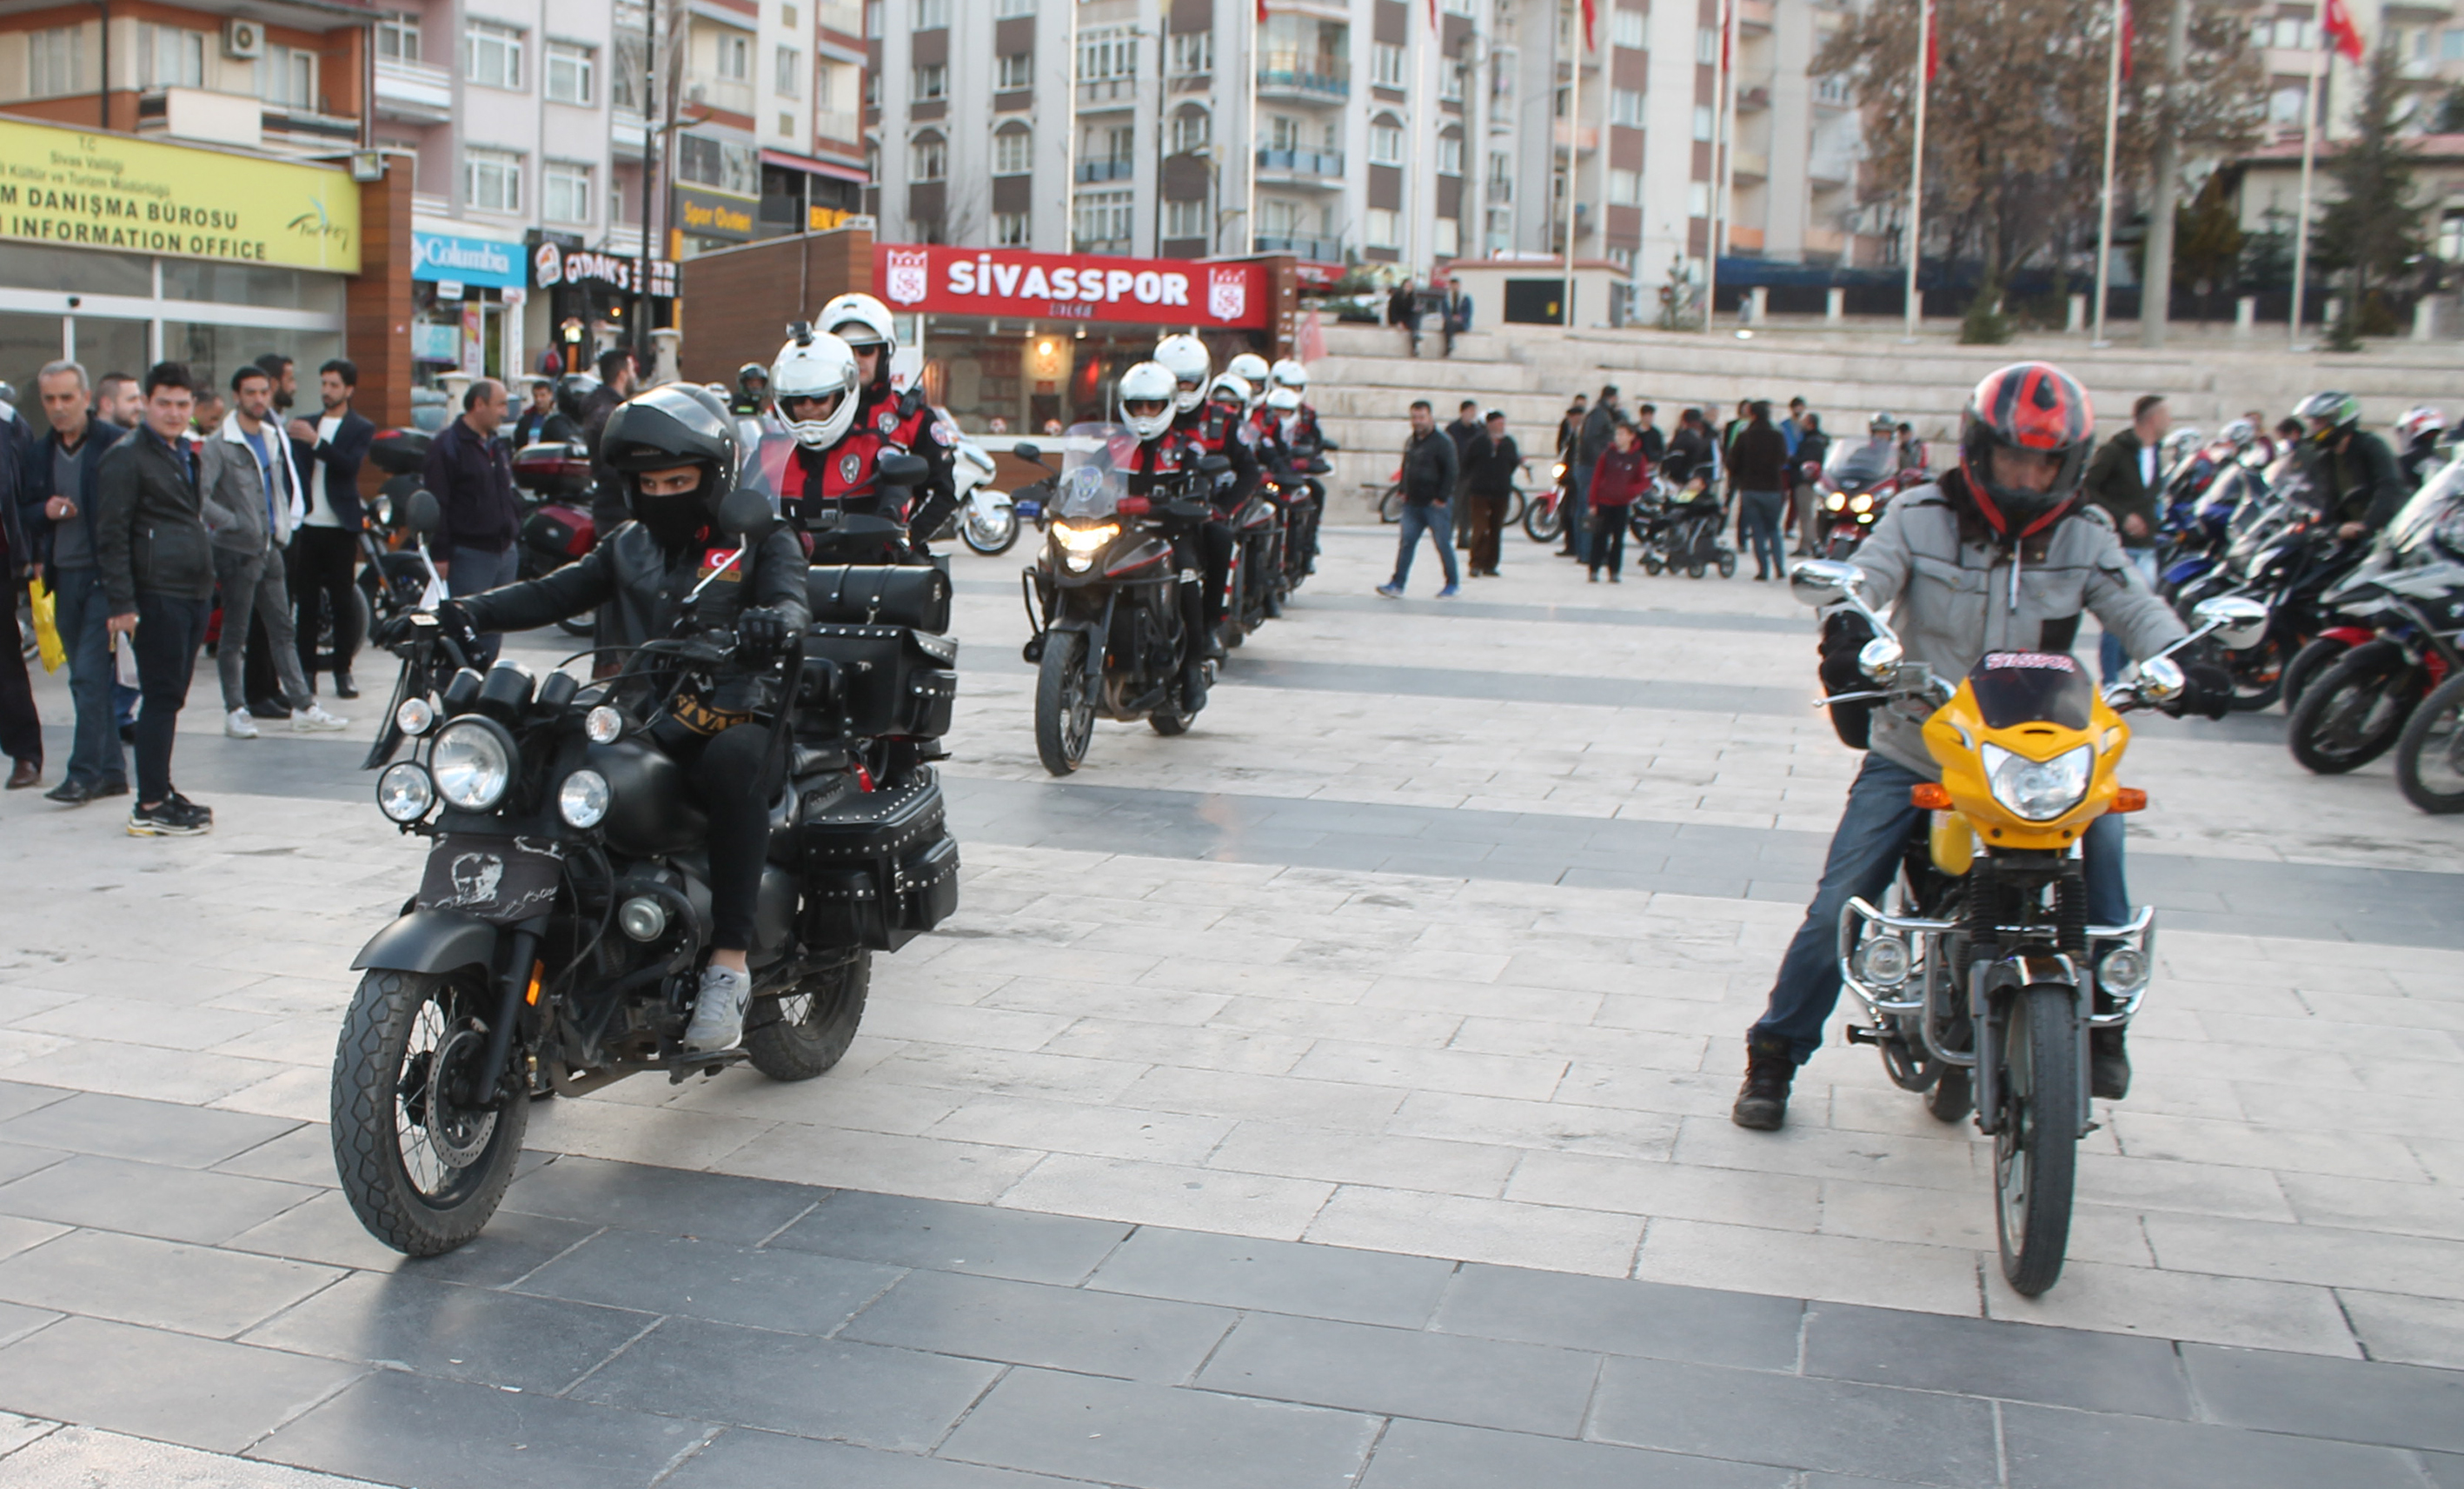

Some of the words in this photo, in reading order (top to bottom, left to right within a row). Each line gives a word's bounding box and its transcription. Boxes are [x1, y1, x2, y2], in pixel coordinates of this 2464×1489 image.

[50, 150, 83, 168] Sivas
[28, 186, 137, 219] DANIŞMA
[147, 200, 237, 229] BÜROSU
[12, 216, 181, 251] INFORMATION
[189, 235, 265, 260] OFFICE
[424, 236, 509, 274] Columbia
[947, 253, 1190, 306] SİVASSPOR
